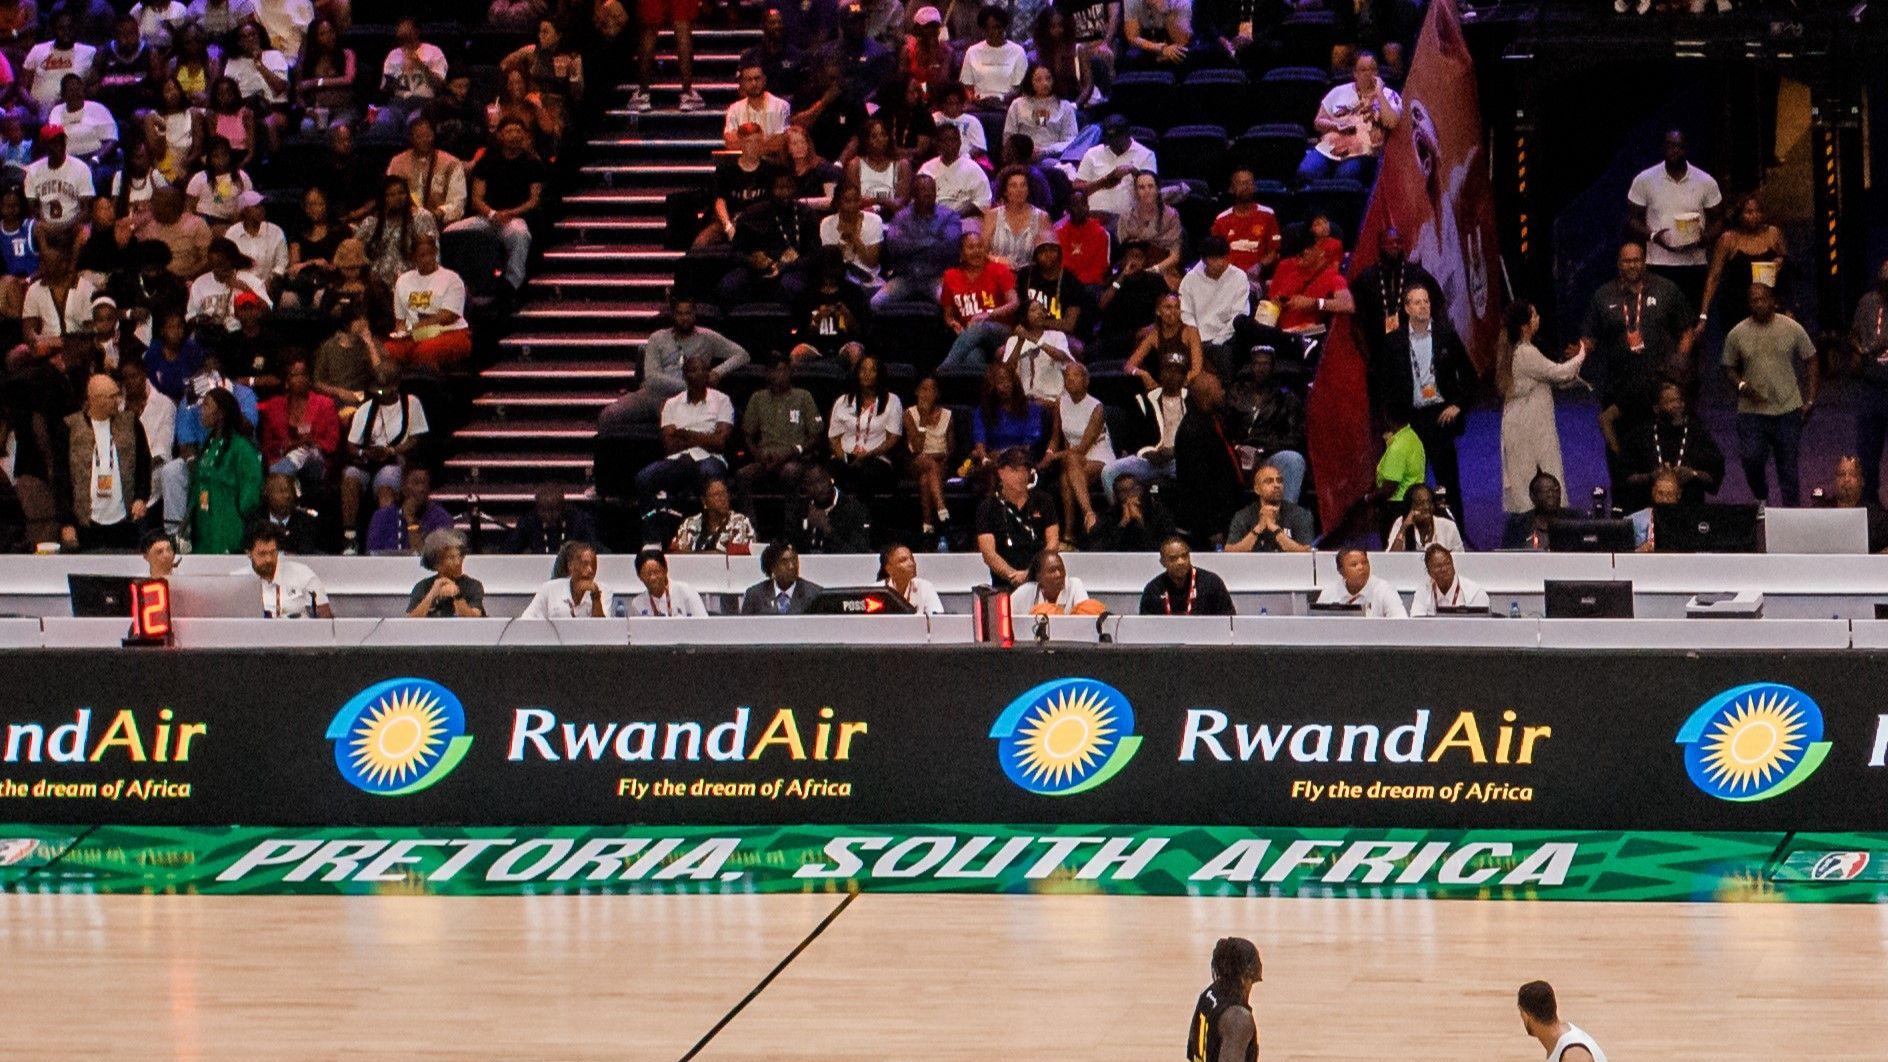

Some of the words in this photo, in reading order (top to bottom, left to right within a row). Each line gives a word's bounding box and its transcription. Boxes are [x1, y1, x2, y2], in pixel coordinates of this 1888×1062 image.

[130, 580, 168, 636] 12
[507, 705, 868, 762] RwandAir
[1178, 708, 1552, 765] RwandAir
[33, 779, 96, 798] dream
[102, 779, 124, 801] of
[125, 779, 192, 801] Africa
[616, 778, 651, 800] Fly
[653, 778, 687, 798] the
[690, 778, 756, 798] dream
[761, 778, 784, 800] of
[786, 778, 852, 800] Africa
[1291, 780, 1325, 802] Fly
[1328, 781, 1362, 799] the
[1366, 781, 1434, 800] dream
[1438, 782, 1463, 802] of
[1465, 782, 1534, 803] Africa
[792, 836, 1171, 880] SOUTH
[1187, 838, 1579, 886] AFRICA
